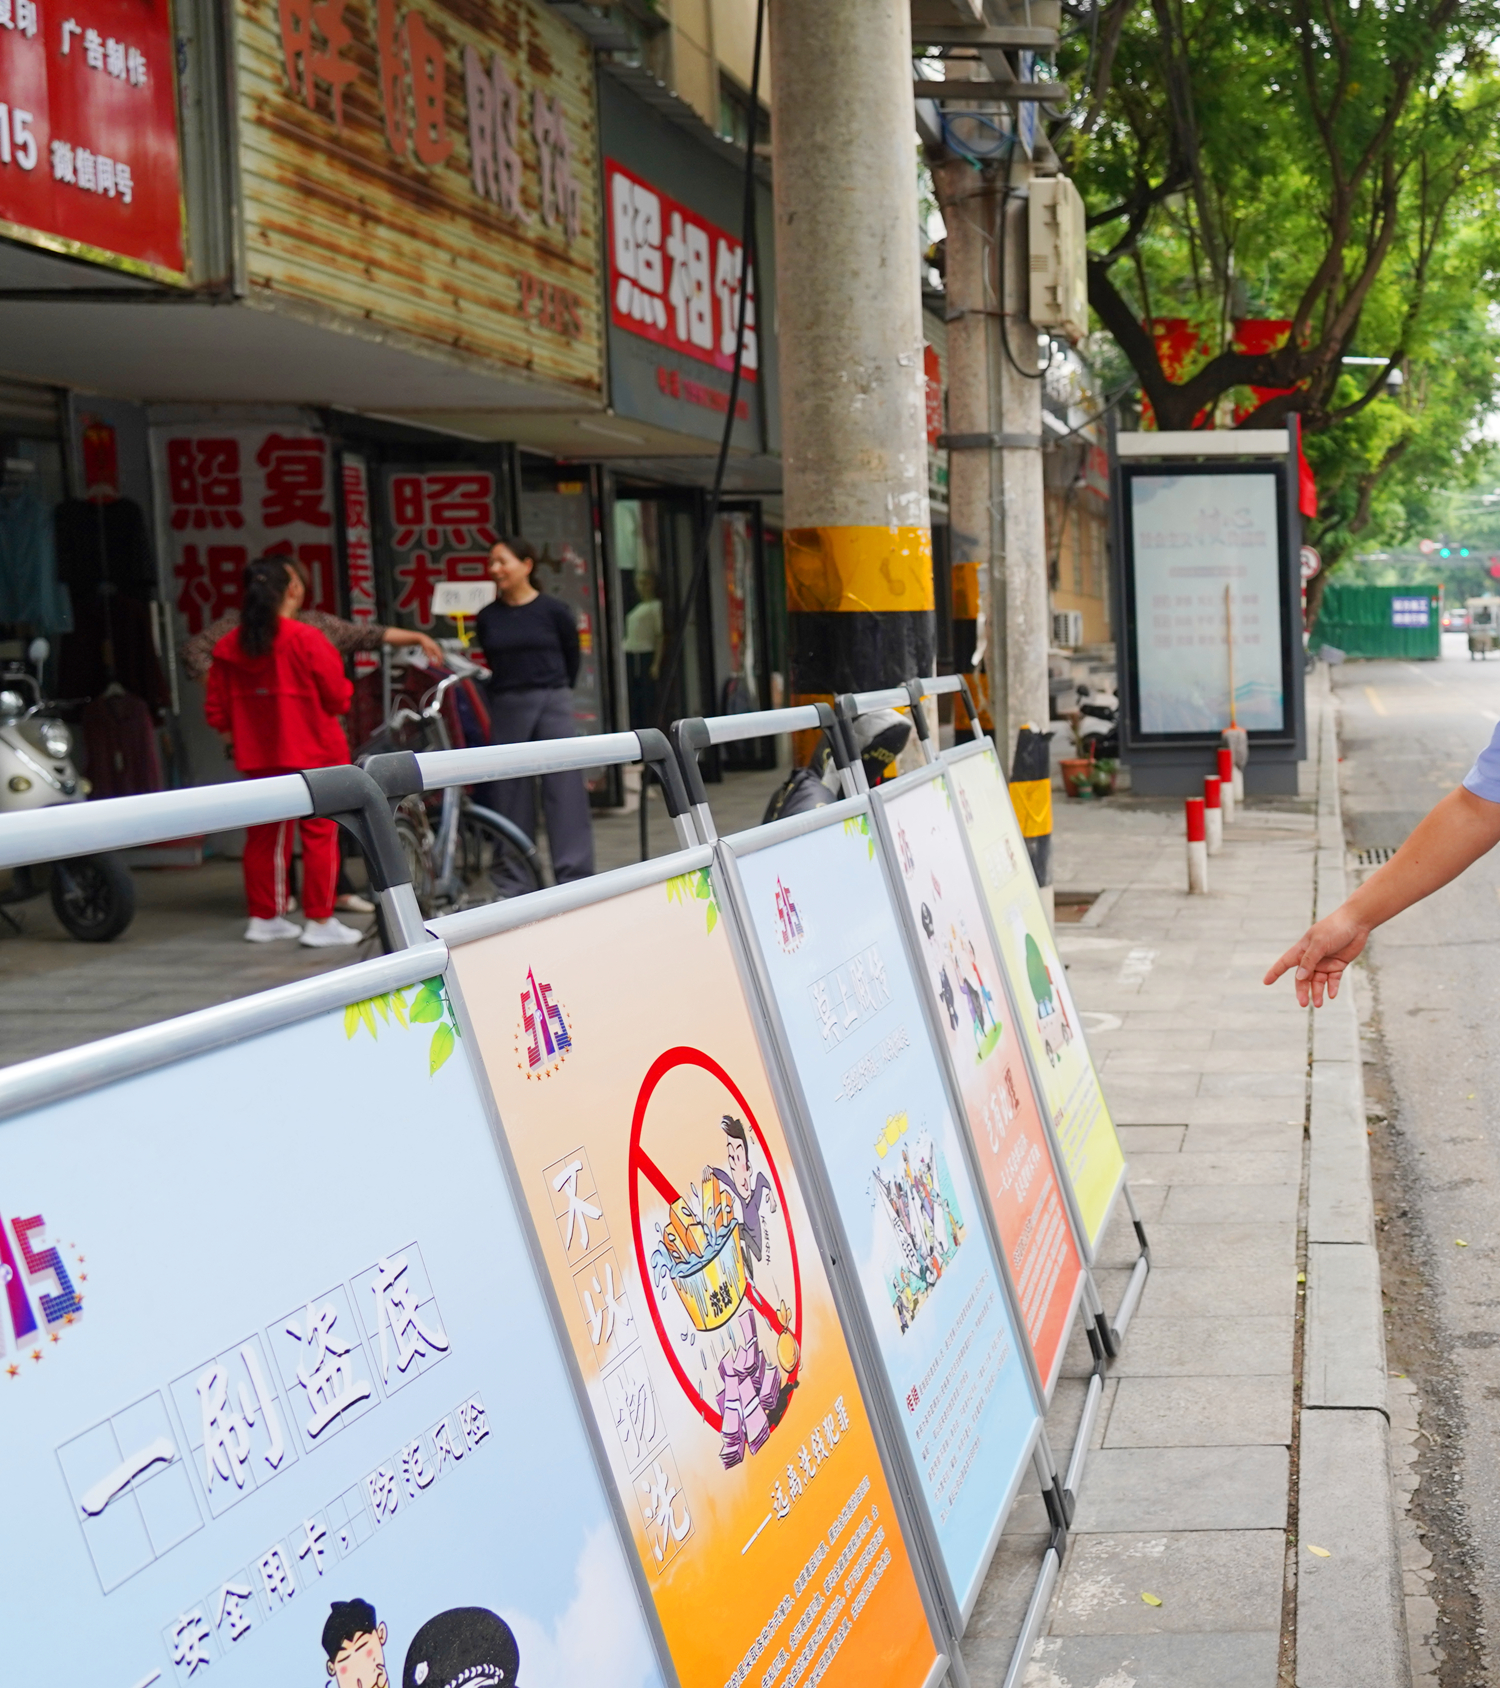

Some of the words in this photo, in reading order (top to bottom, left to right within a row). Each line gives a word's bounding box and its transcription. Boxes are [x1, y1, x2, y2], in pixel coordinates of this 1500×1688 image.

[61, 17, 149, 88] 广告制作
[50, 139, 135, 205] 微信同号
[612, 172, 758, 370] 照相馆
[519, 965, 575, 1072] 515
[80, 1255, 451, 1517] 一刷盗底
[552, 1159, 692, 1563] 不以物洗
